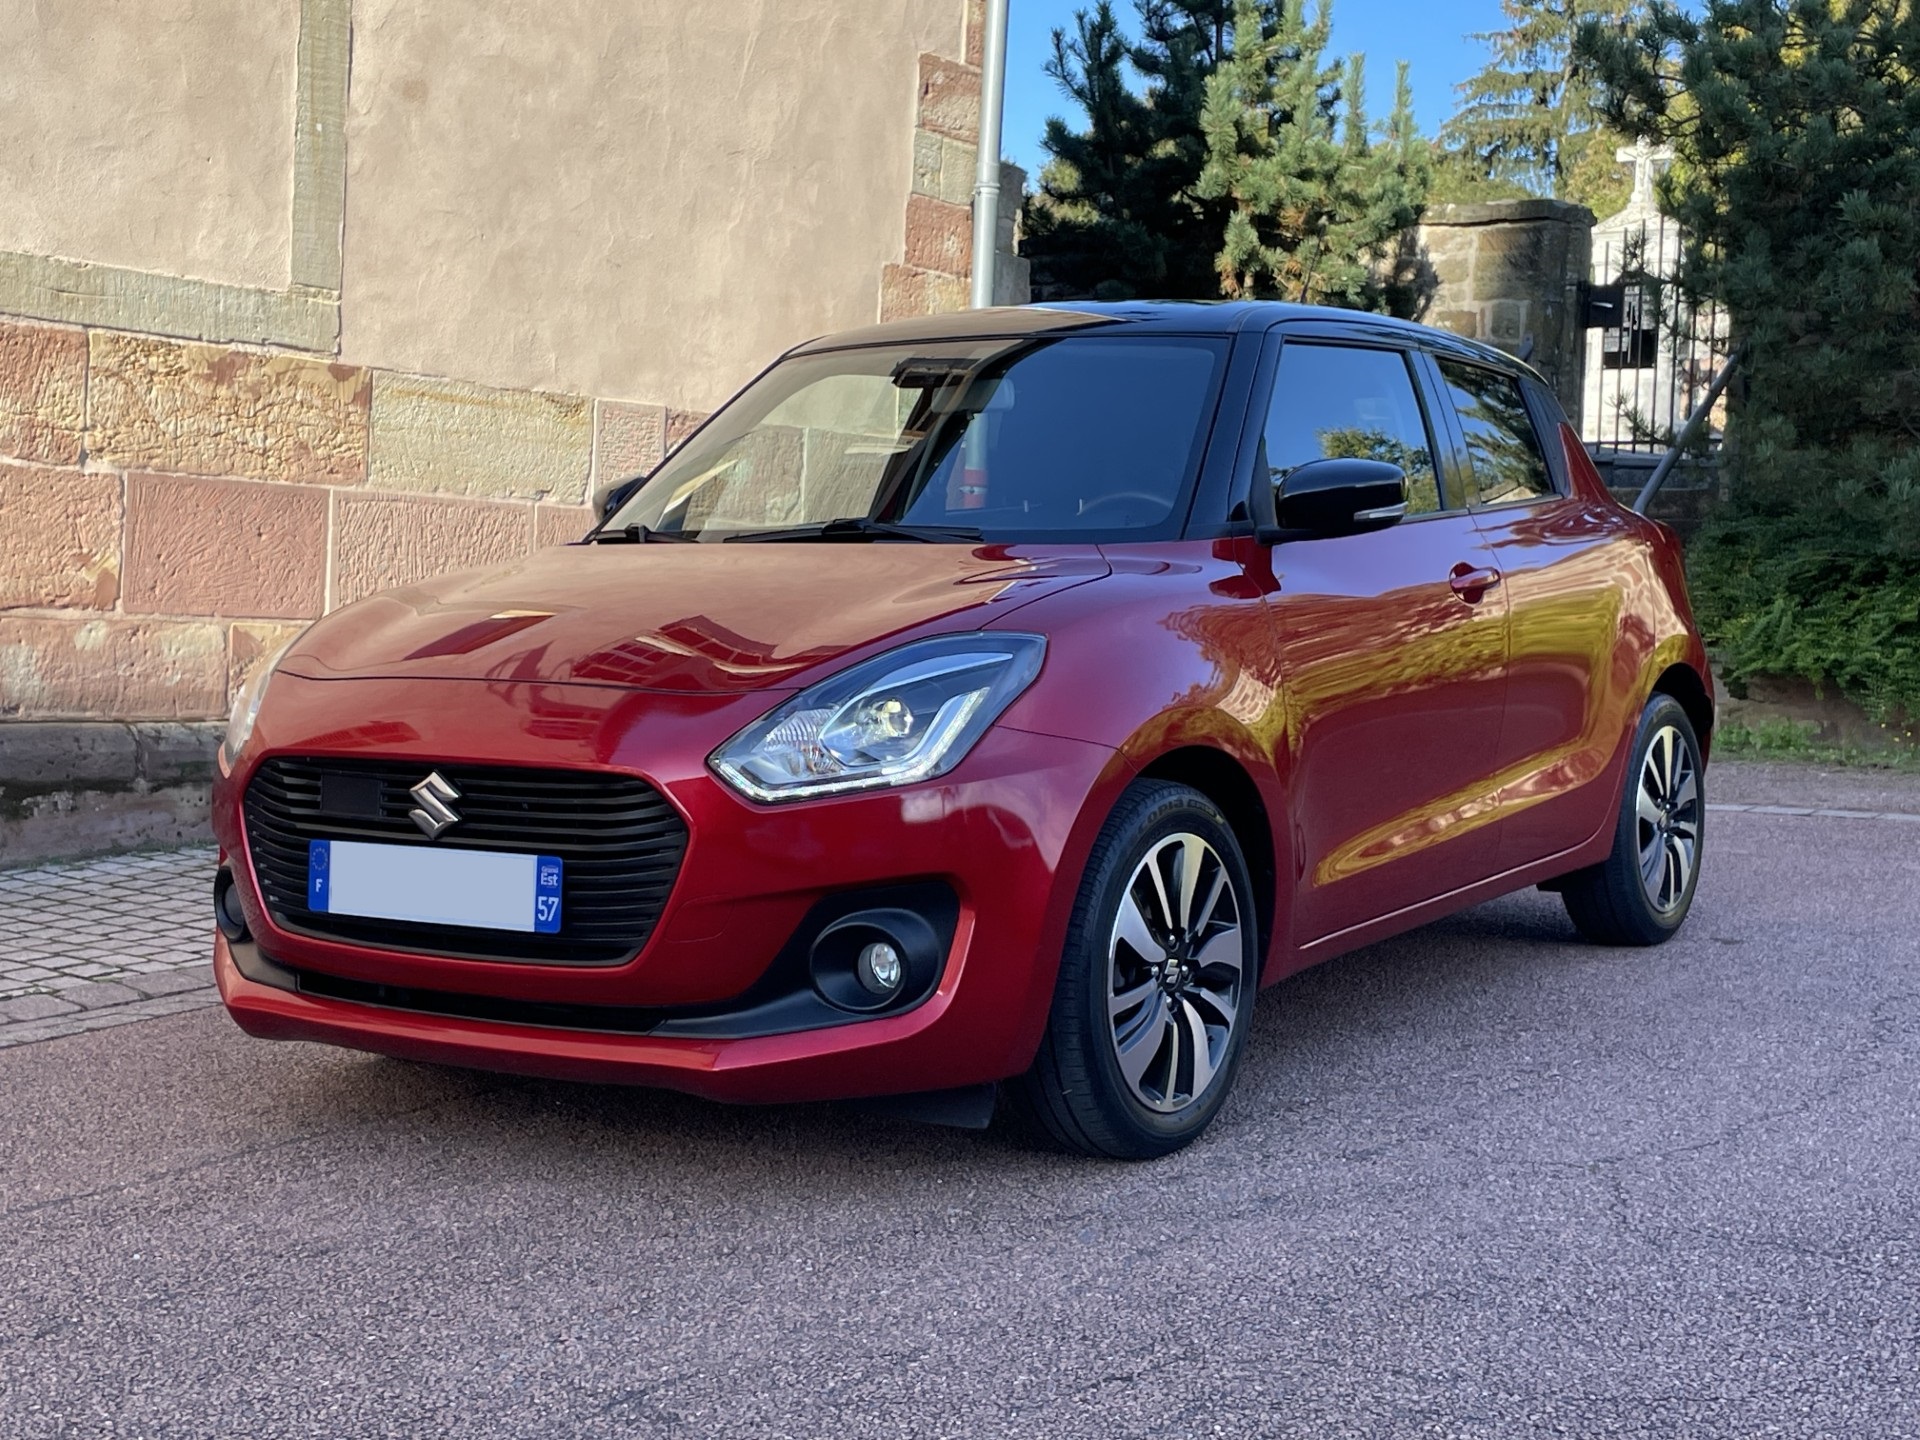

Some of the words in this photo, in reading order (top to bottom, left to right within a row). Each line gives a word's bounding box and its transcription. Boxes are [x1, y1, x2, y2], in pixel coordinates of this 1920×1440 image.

[316, 879, 323, 892] F
[541, 873, 558, 887] Est
[538, 895, 559, 922] 57
